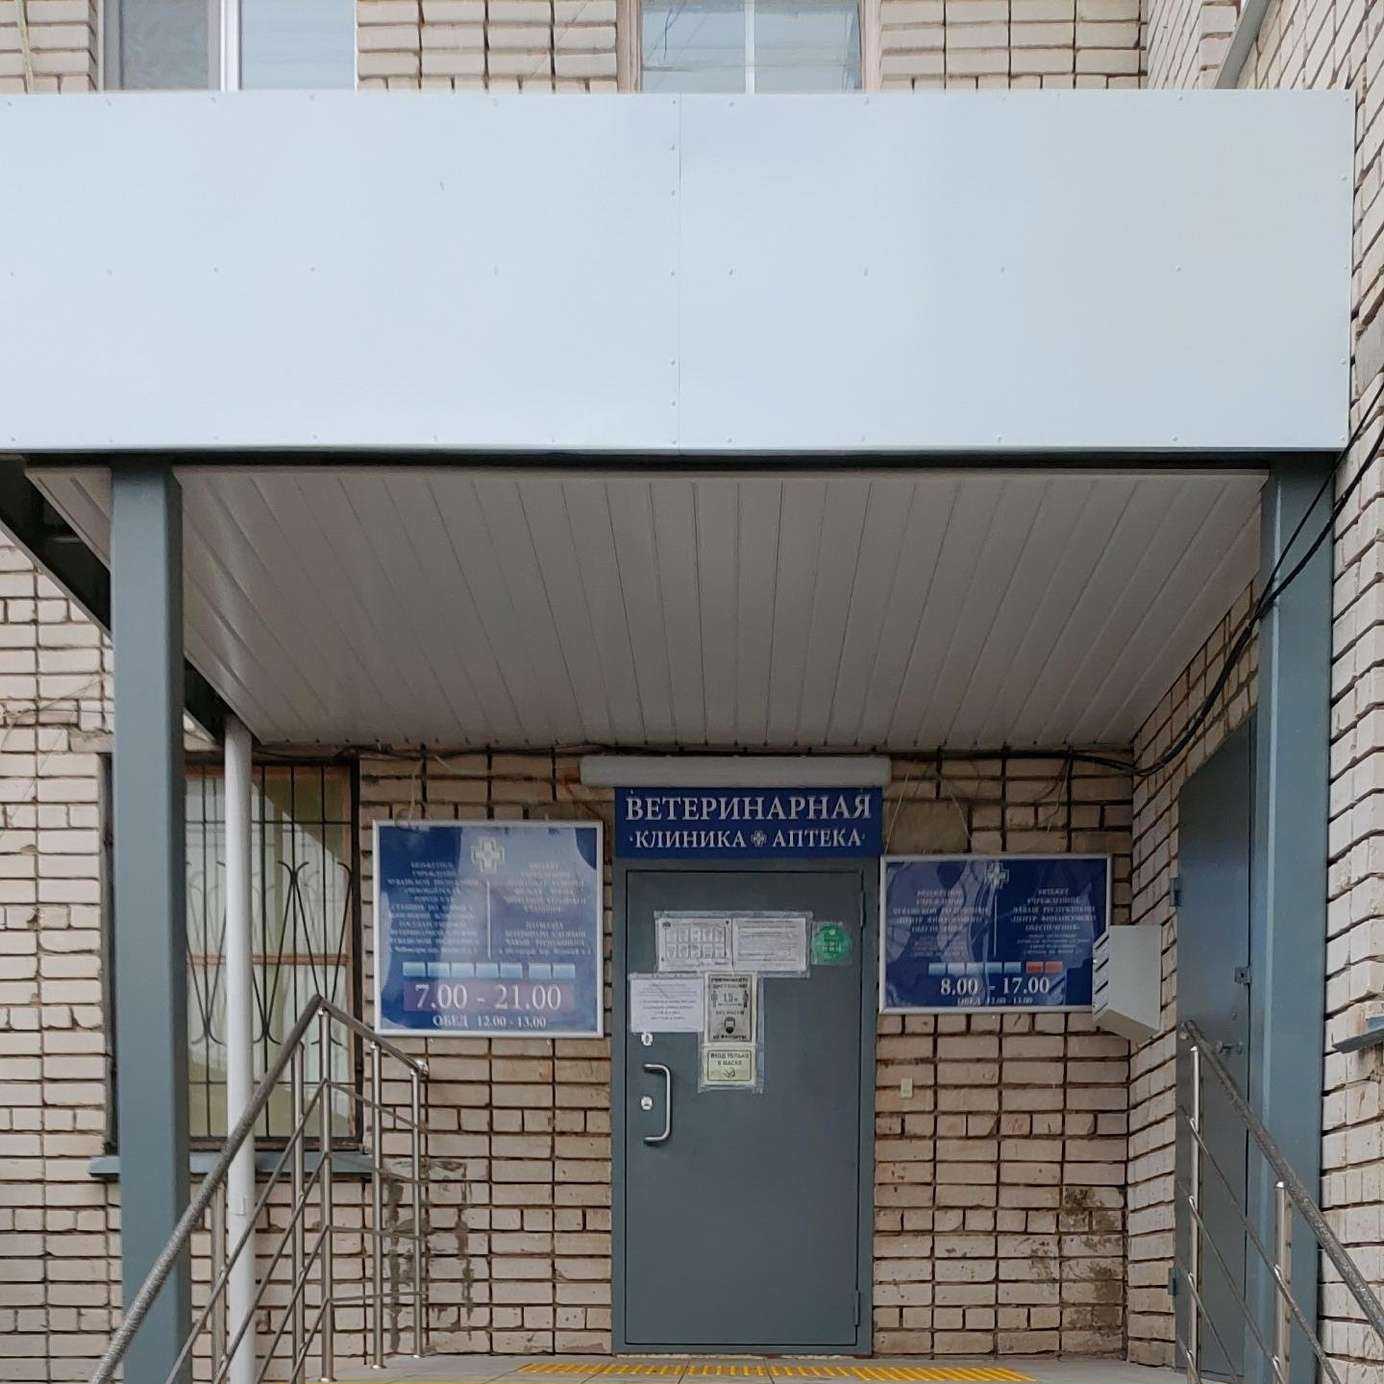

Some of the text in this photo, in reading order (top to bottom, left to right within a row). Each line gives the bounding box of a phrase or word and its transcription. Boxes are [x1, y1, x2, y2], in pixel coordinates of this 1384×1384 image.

[625, 794, 871, 821] ВЕТЕРИНАРНАЯ
[634, 829, 861, 848] КЛИНИКА АПТЕКА
[940, 977, 978, 996] 8.00
[1002, 976, 1050, 995] 17.00
[415, 984, 468, 1010] 7.00
[494, 984, 562, 1010] 21.00
[477, 1015, 507, 1027] 12.00
